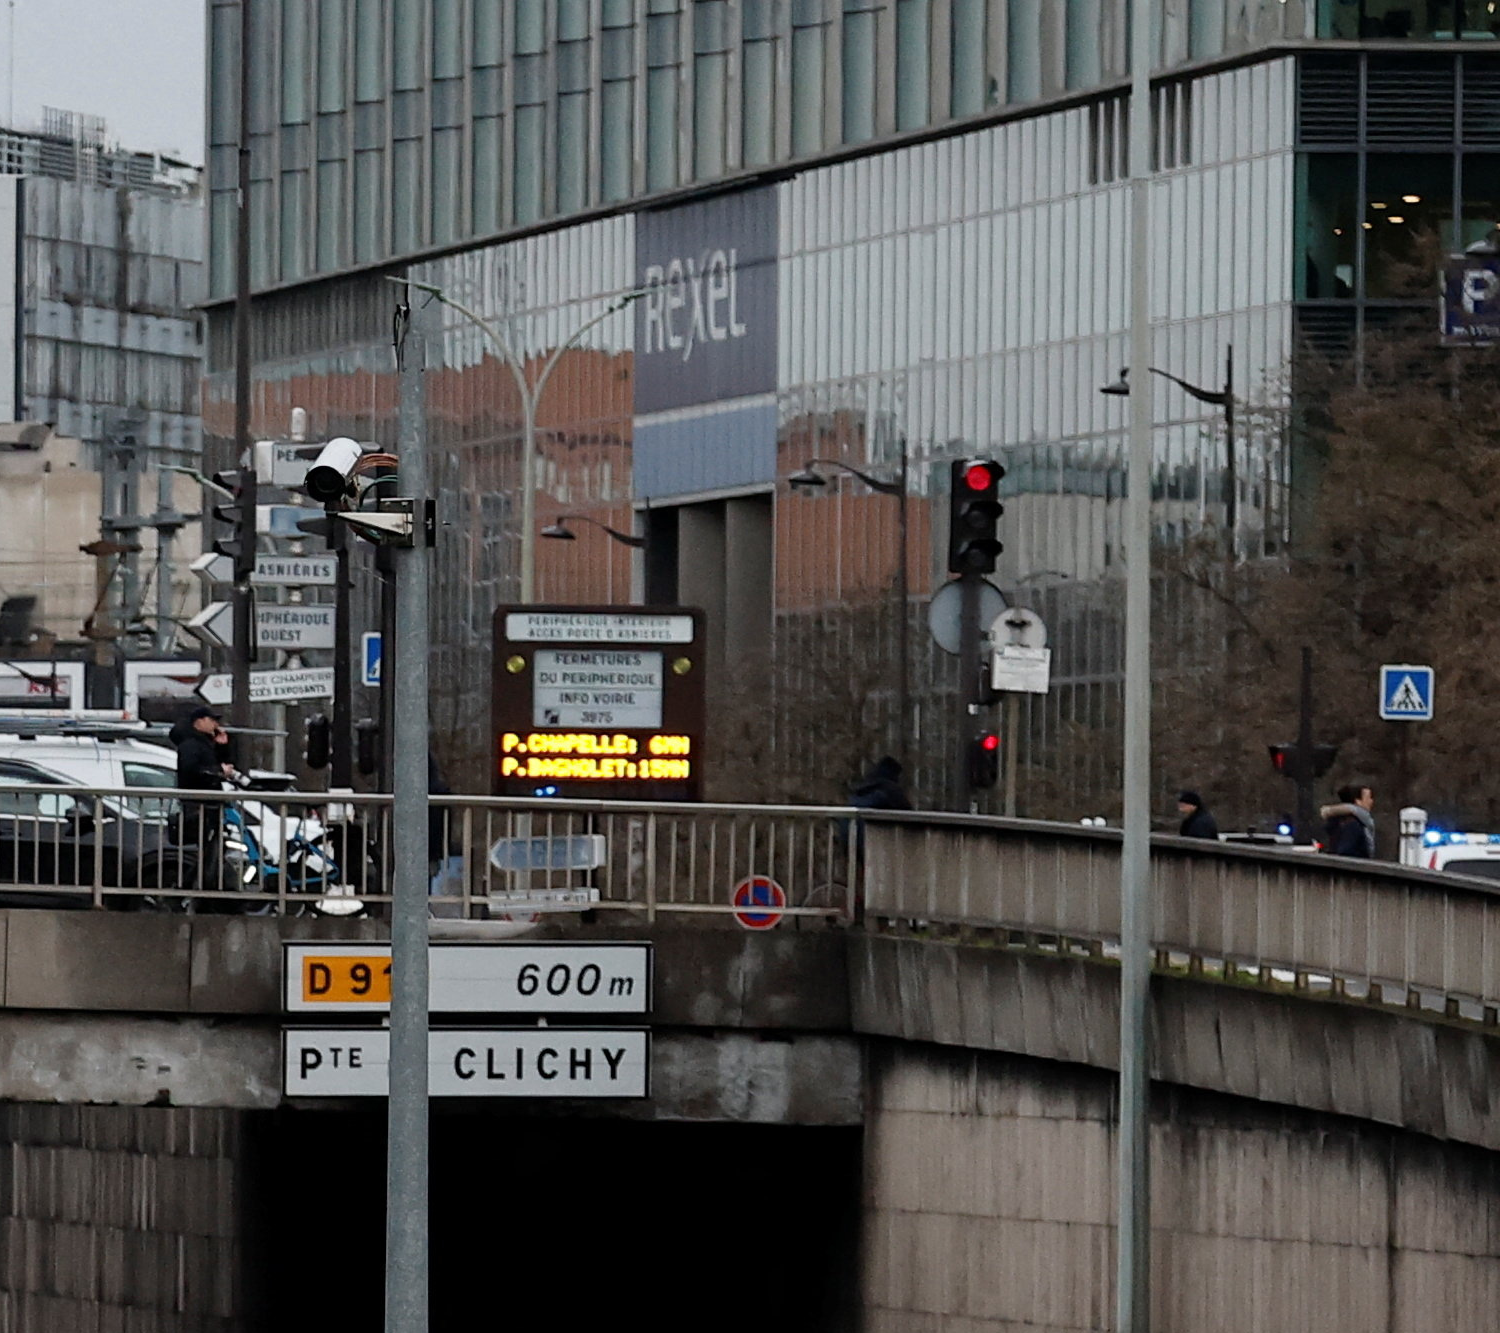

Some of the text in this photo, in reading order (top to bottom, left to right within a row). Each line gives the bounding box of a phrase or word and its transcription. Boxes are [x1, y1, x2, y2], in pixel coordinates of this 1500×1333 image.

[555, 653, 642, 666] FERMETURES
[540, 672, 558, 684] DU
[559, 693, 636, 705] INFO VOIRIE
[309, 963, 332, 995] D
[517, 963, 601, 997] 600
[608, 976, 634, 996] m
[454, 1047, 626, 1081] CLICHY
